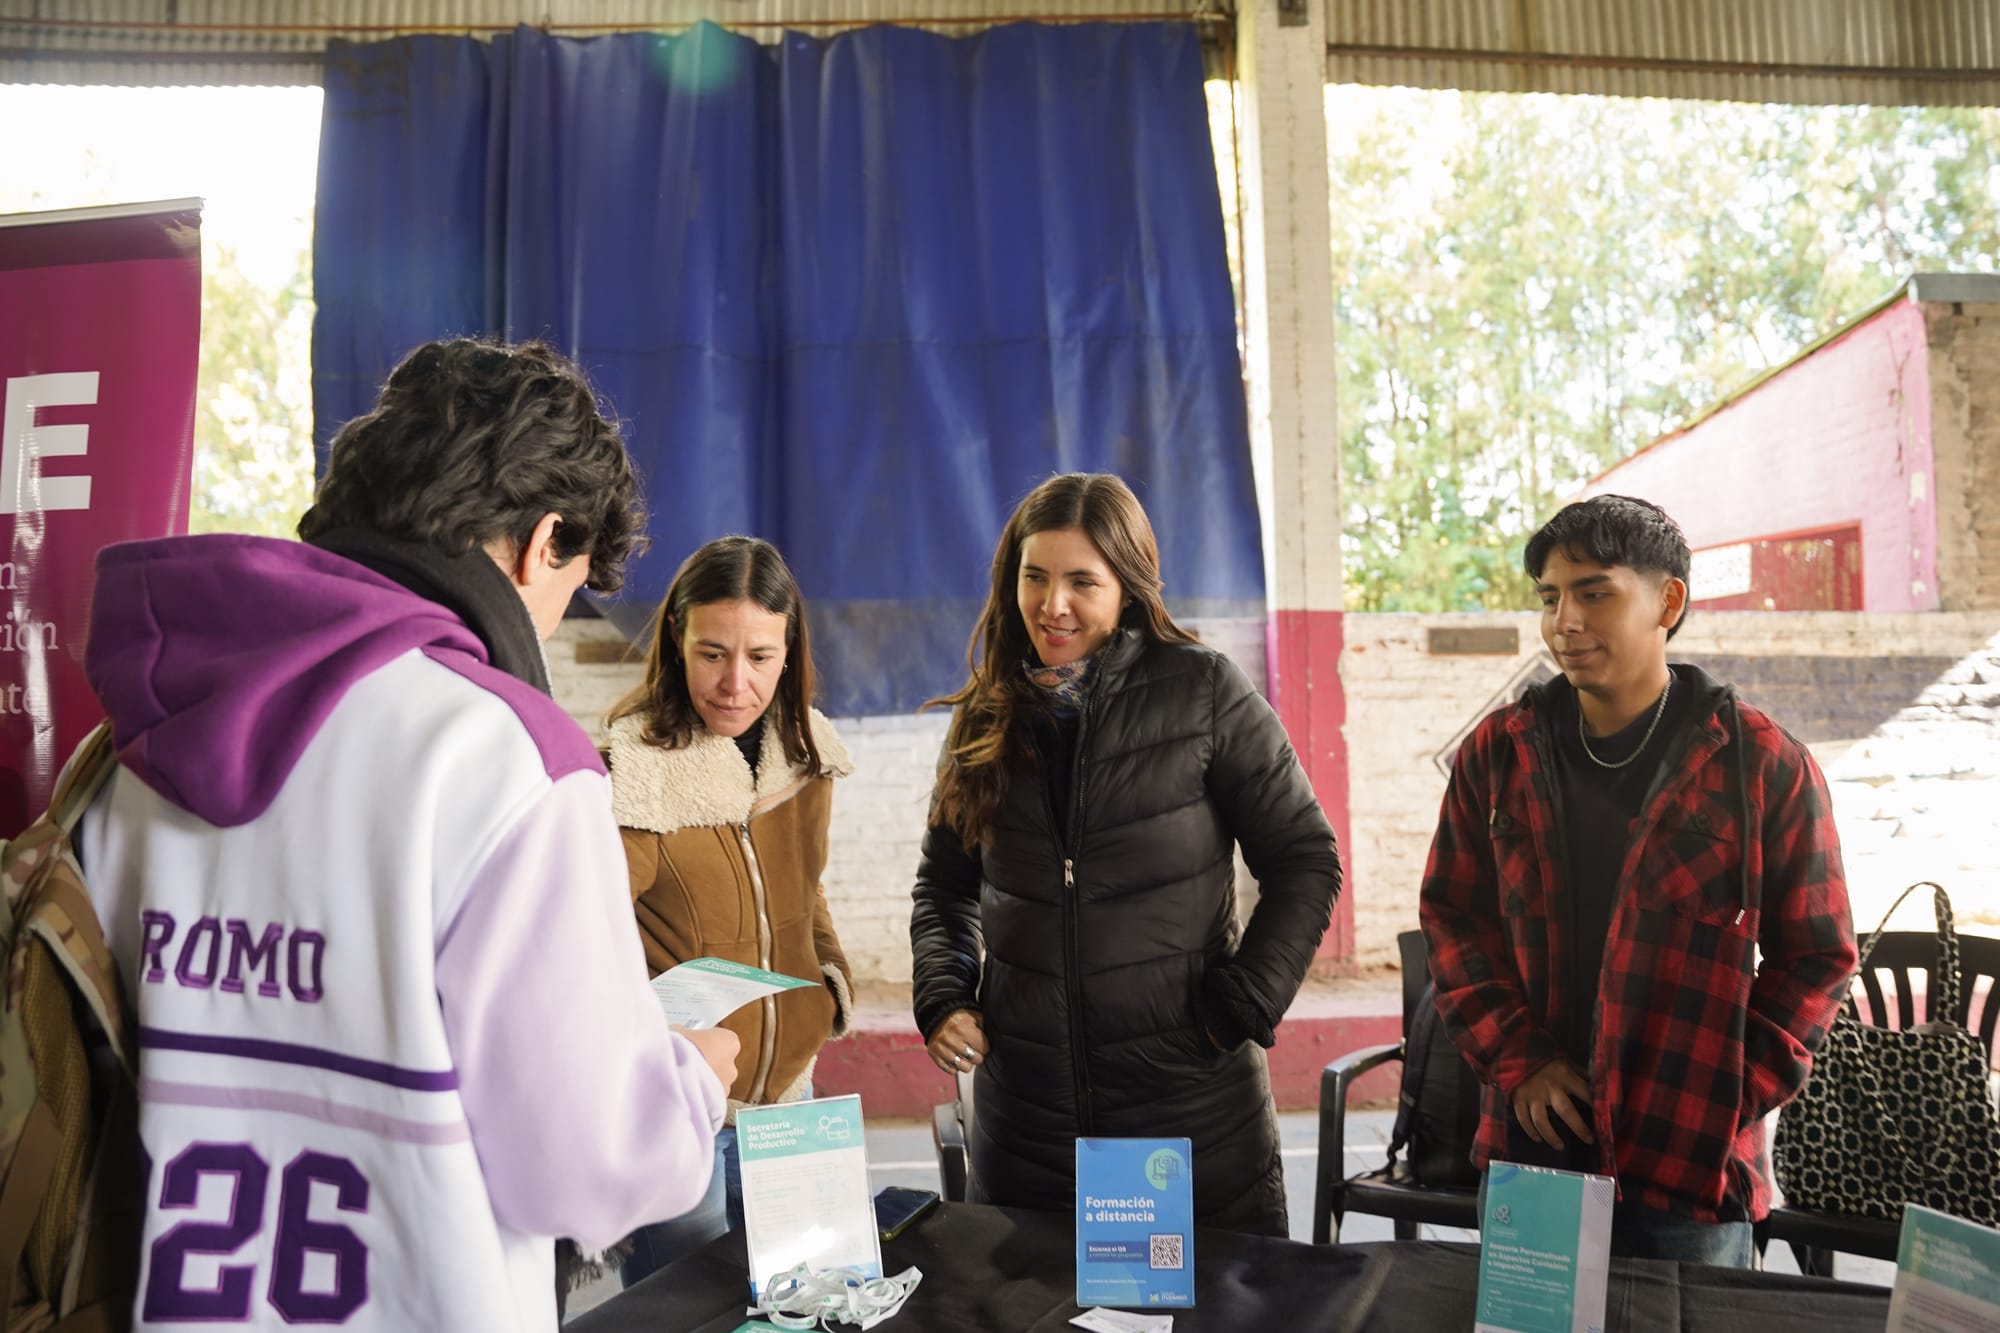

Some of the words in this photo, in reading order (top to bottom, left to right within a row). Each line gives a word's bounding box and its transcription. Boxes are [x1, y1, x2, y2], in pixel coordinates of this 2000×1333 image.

[0, 609, 59, 652] ión
[1085, 1196, 1155, 1209] Formación
[1085, 1212, 1093, 1222] a
[1096, 1210, 1155, 1222] distancia
[143, 1140, 370, 1325] 26
